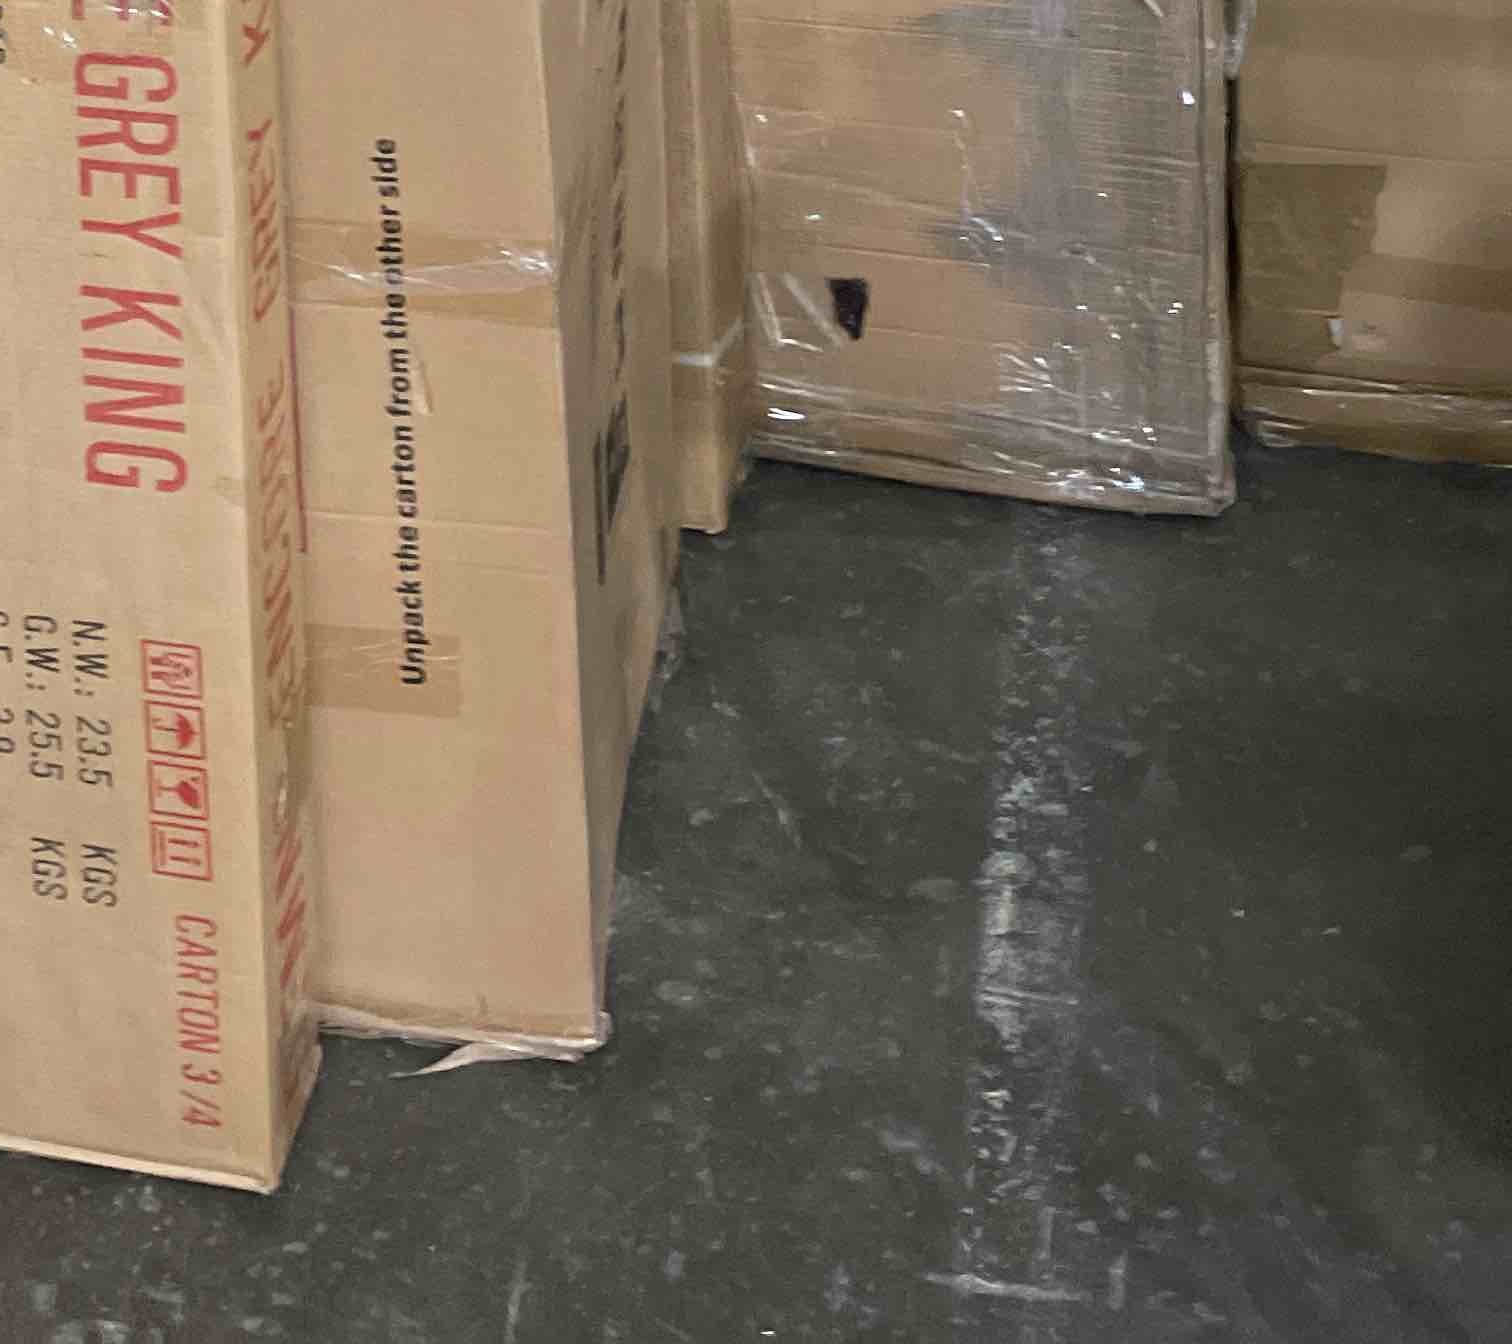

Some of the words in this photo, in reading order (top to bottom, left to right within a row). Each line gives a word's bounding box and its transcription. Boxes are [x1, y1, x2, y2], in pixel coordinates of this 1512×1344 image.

[73, 51, 185, 259] GREY
[369, 138, 398, 198] side
[374, 205, 405, 286] other
[379, 293, 406, 340] the
[79, 284, 188, 493] KING
[382, 348, 410, 417] from
[391, 424, 420, 519] carton
[393, 525, 420, 572] the
[391, 579, 433, 685] Unpack
[25, 709, 65, 781] 25.5
[76, 715, 113, 787] 23.5
[30, 836, 68, 901] KGS
[81, 843, 118, 907] KGS
[175, 914, 222, 1054] CARTON
